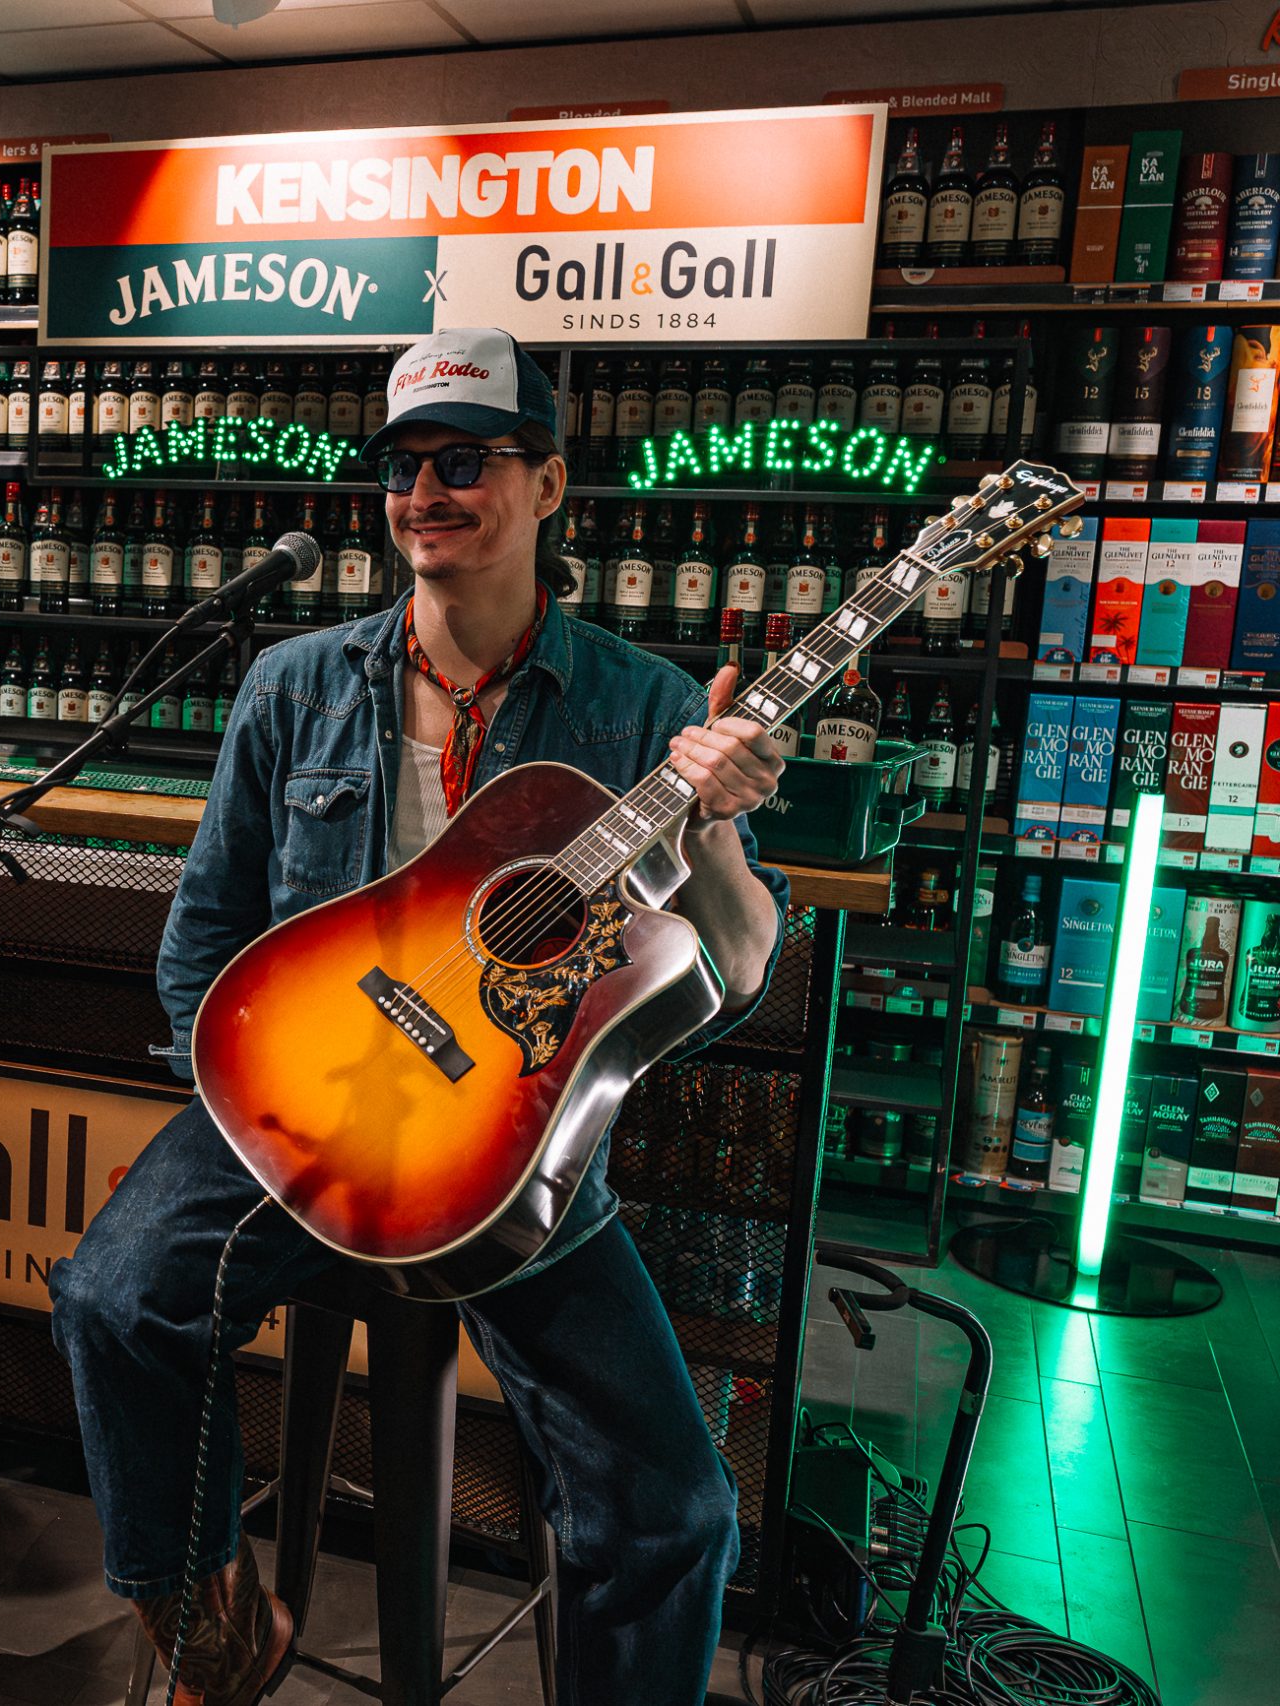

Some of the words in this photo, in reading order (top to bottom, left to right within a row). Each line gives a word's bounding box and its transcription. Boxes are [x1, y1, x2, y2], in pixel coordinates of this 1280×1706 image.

[902, 94, 957, 108] Blended
[961, 92, 991, 104] Malt
[3, 143, 28, 157] Iers
[1140, 172, 1165, 182] LAN
[215, 146, 655, 226] KENSINGTON
[1090, 181, 1115, 190] LAN
[109, 253, 371, 326] JAMESON
[562, 314, 641, 330] SINDS
[657, 313, 717, 329] 1884
[429, 361, 490, 380] Rodeo
[780, 387, 814, 399] AMESON
[905, 386, 940, 399] AMESON
[1084, 386, 1100, 399] 12
[1135, 386, 1149, 400] 15
[1197, 386, 1212, 400] 18
[103, 416, 350, 482] JAMESON
[628, 418, 934, 493] JAMESON
[94, 543, 121, 554] AMESON
[143, 544, 173, 555] AMESON
[1052, 549, 1092, 559] GLENLIVET
[1104, 551, 1144, 560] GLENLIVET
[1151, 553, 1192, 562] GLENLIVET
[1165, 560, 1176, 568] 12
[1197, 554, 1239, 563] GLENLIVET
[816, 723, 873, 744] JAMESON
[1027, 722, 1069, 739] GLEN
[1072, 725, 1115, 742] GLEN
[1124, 728, 1167, 745] GLEN
[1040, 738, 1069, 752] MO
[1171, 731, 1216, 748] GLEN
[1085, 741, 1115, 756] MO
[1137, 744, 1167, 759] MO
[1185, 747, 1215, 763] MO
[1024, 749, 1057, 765] RAN
[1068, 752, 1103, 768] RAN
[1120, 756, 1155, 773] RAN
[1168, 760, 1204, 776] RAN
[1035, 765, 1062, 779] GIE
[1081, 768, 1108, 784] GIE
[1132, 771, 1160, 787] GIE
[1180, 775, 1208, 791] GIE
[1213, 781, 1257, 789] FETTERCAIRN
[1228, 795, 1239, 803] 12
[1062, 916, 1114, 933] SINGLETON
[1147, 927, 1178, 939] LETON
[1190, 959, 1224, 969] JURA
[1060, 967, 1074, 979] 12
[1063, 1100, 1091, 1108] MORA
[1159, 1104, 1185, 1114] GLEN
[1152, 1110, 1190, 1122] MORAY
